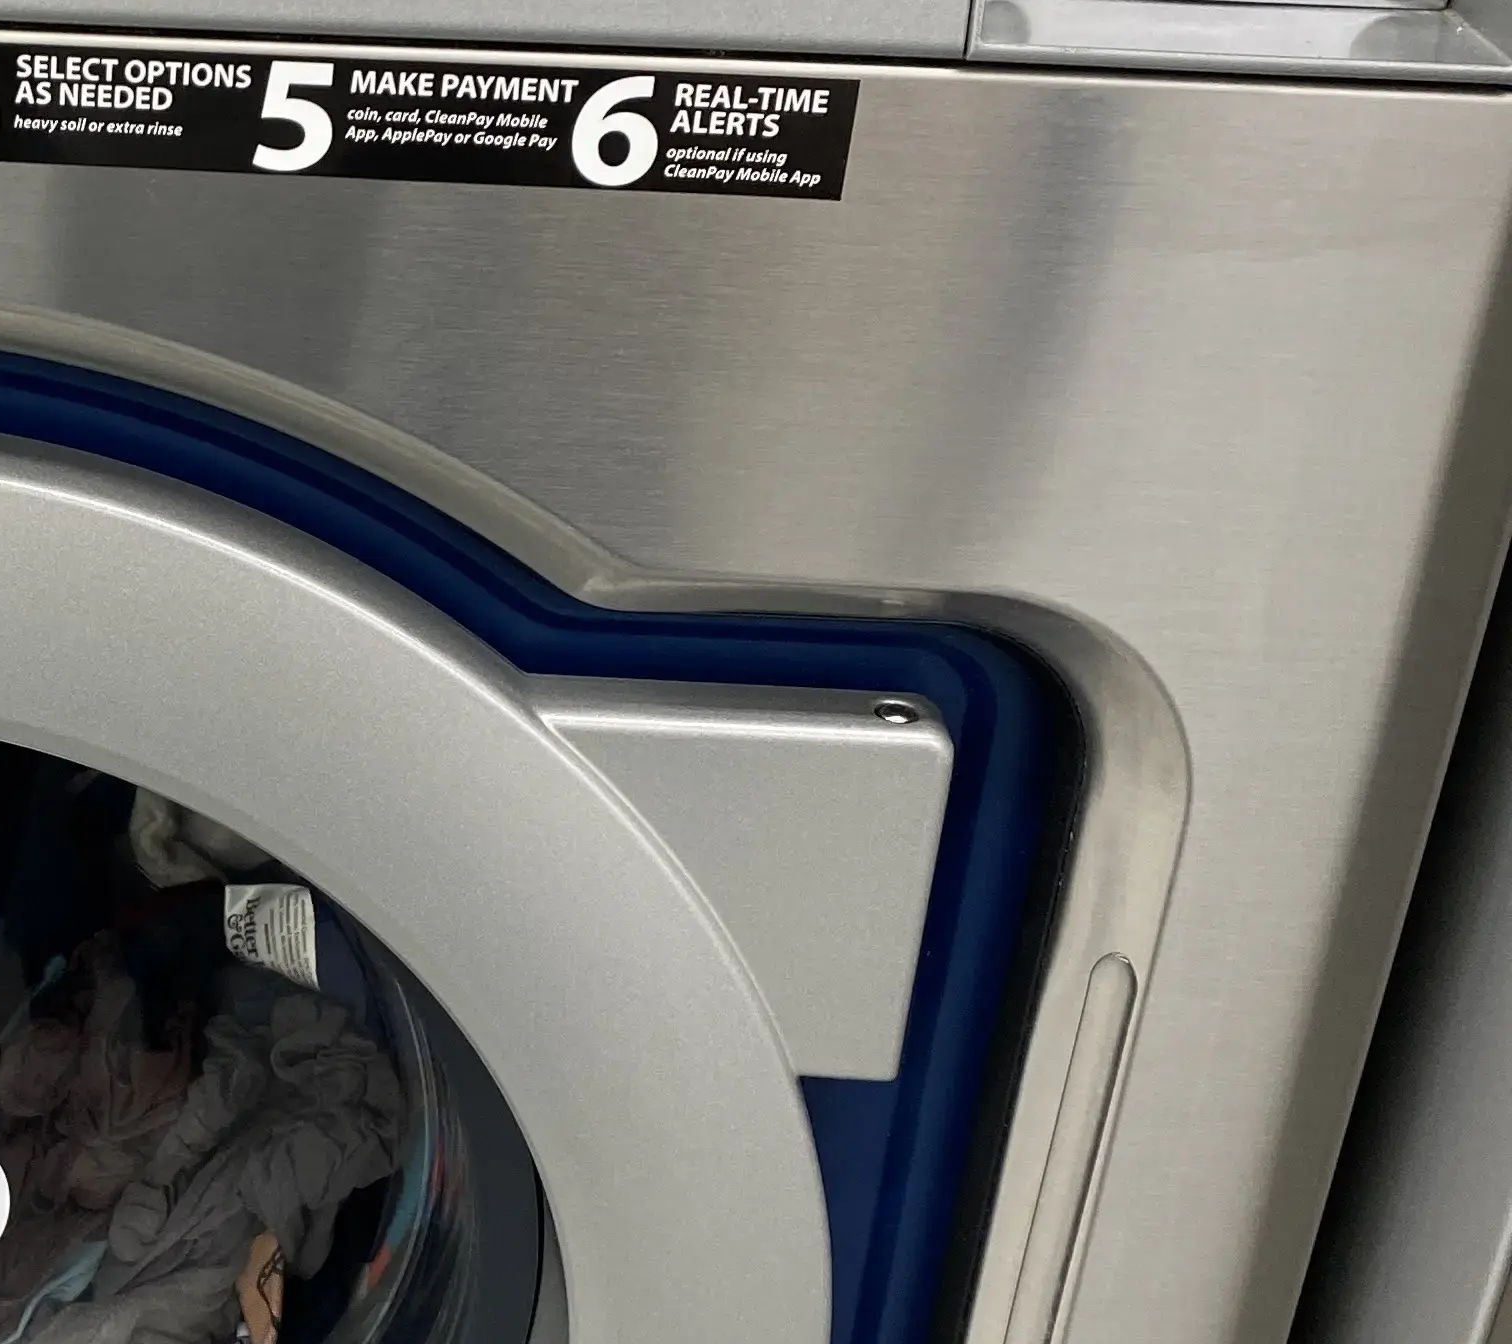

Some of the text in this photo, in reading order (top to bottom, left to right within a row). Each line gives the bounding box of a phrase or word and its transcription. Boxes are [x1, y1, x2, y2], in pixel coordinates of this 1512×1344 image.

[17, 54, 251, 88] SELECT OPTIONS
[15, 81, 172, 110] AS NEEDED
[351, 70, 579, 102] MAKE PAYMENT
[675, 84, 829, 113] REAL-TIME
[14, 114, 182, 136] heavy soil or extra rinse
[252, 60, 335, 172] 5
[347, 107, 548, 129] coin, card, CleanPay Mobile
[670, 110, 780, 137] ALERTS
[571, 75, 659, 187] 6
